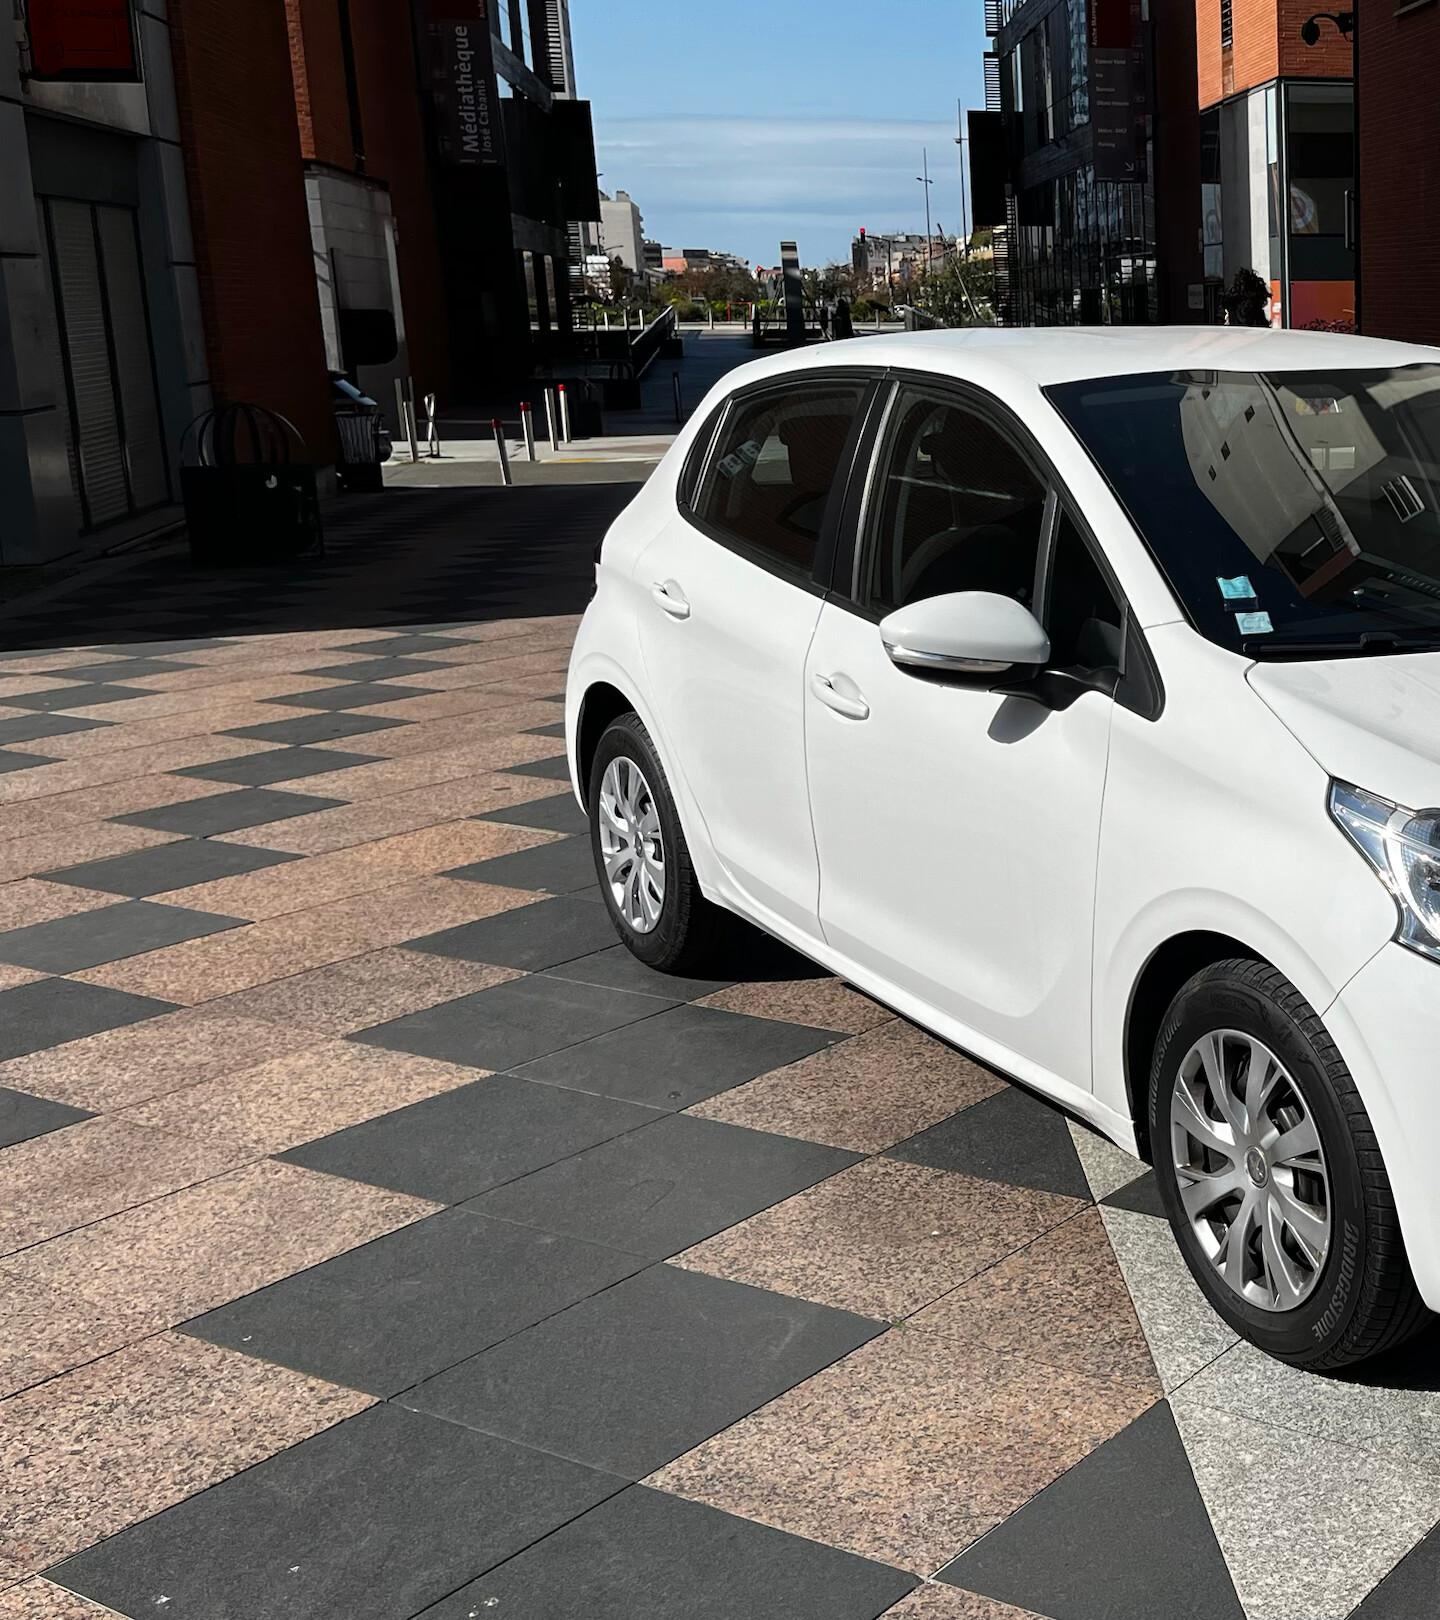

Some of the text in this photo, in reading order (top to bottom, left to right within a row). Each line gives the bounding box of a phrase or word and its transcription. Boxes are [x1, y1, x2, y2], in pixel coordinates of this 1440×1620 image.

[454, 24, 479, 153] Médiathèque
[476, 79, 492, 153] José Cabanis
[1311, 1218, 1361, 1343] BRIDGESTONE
